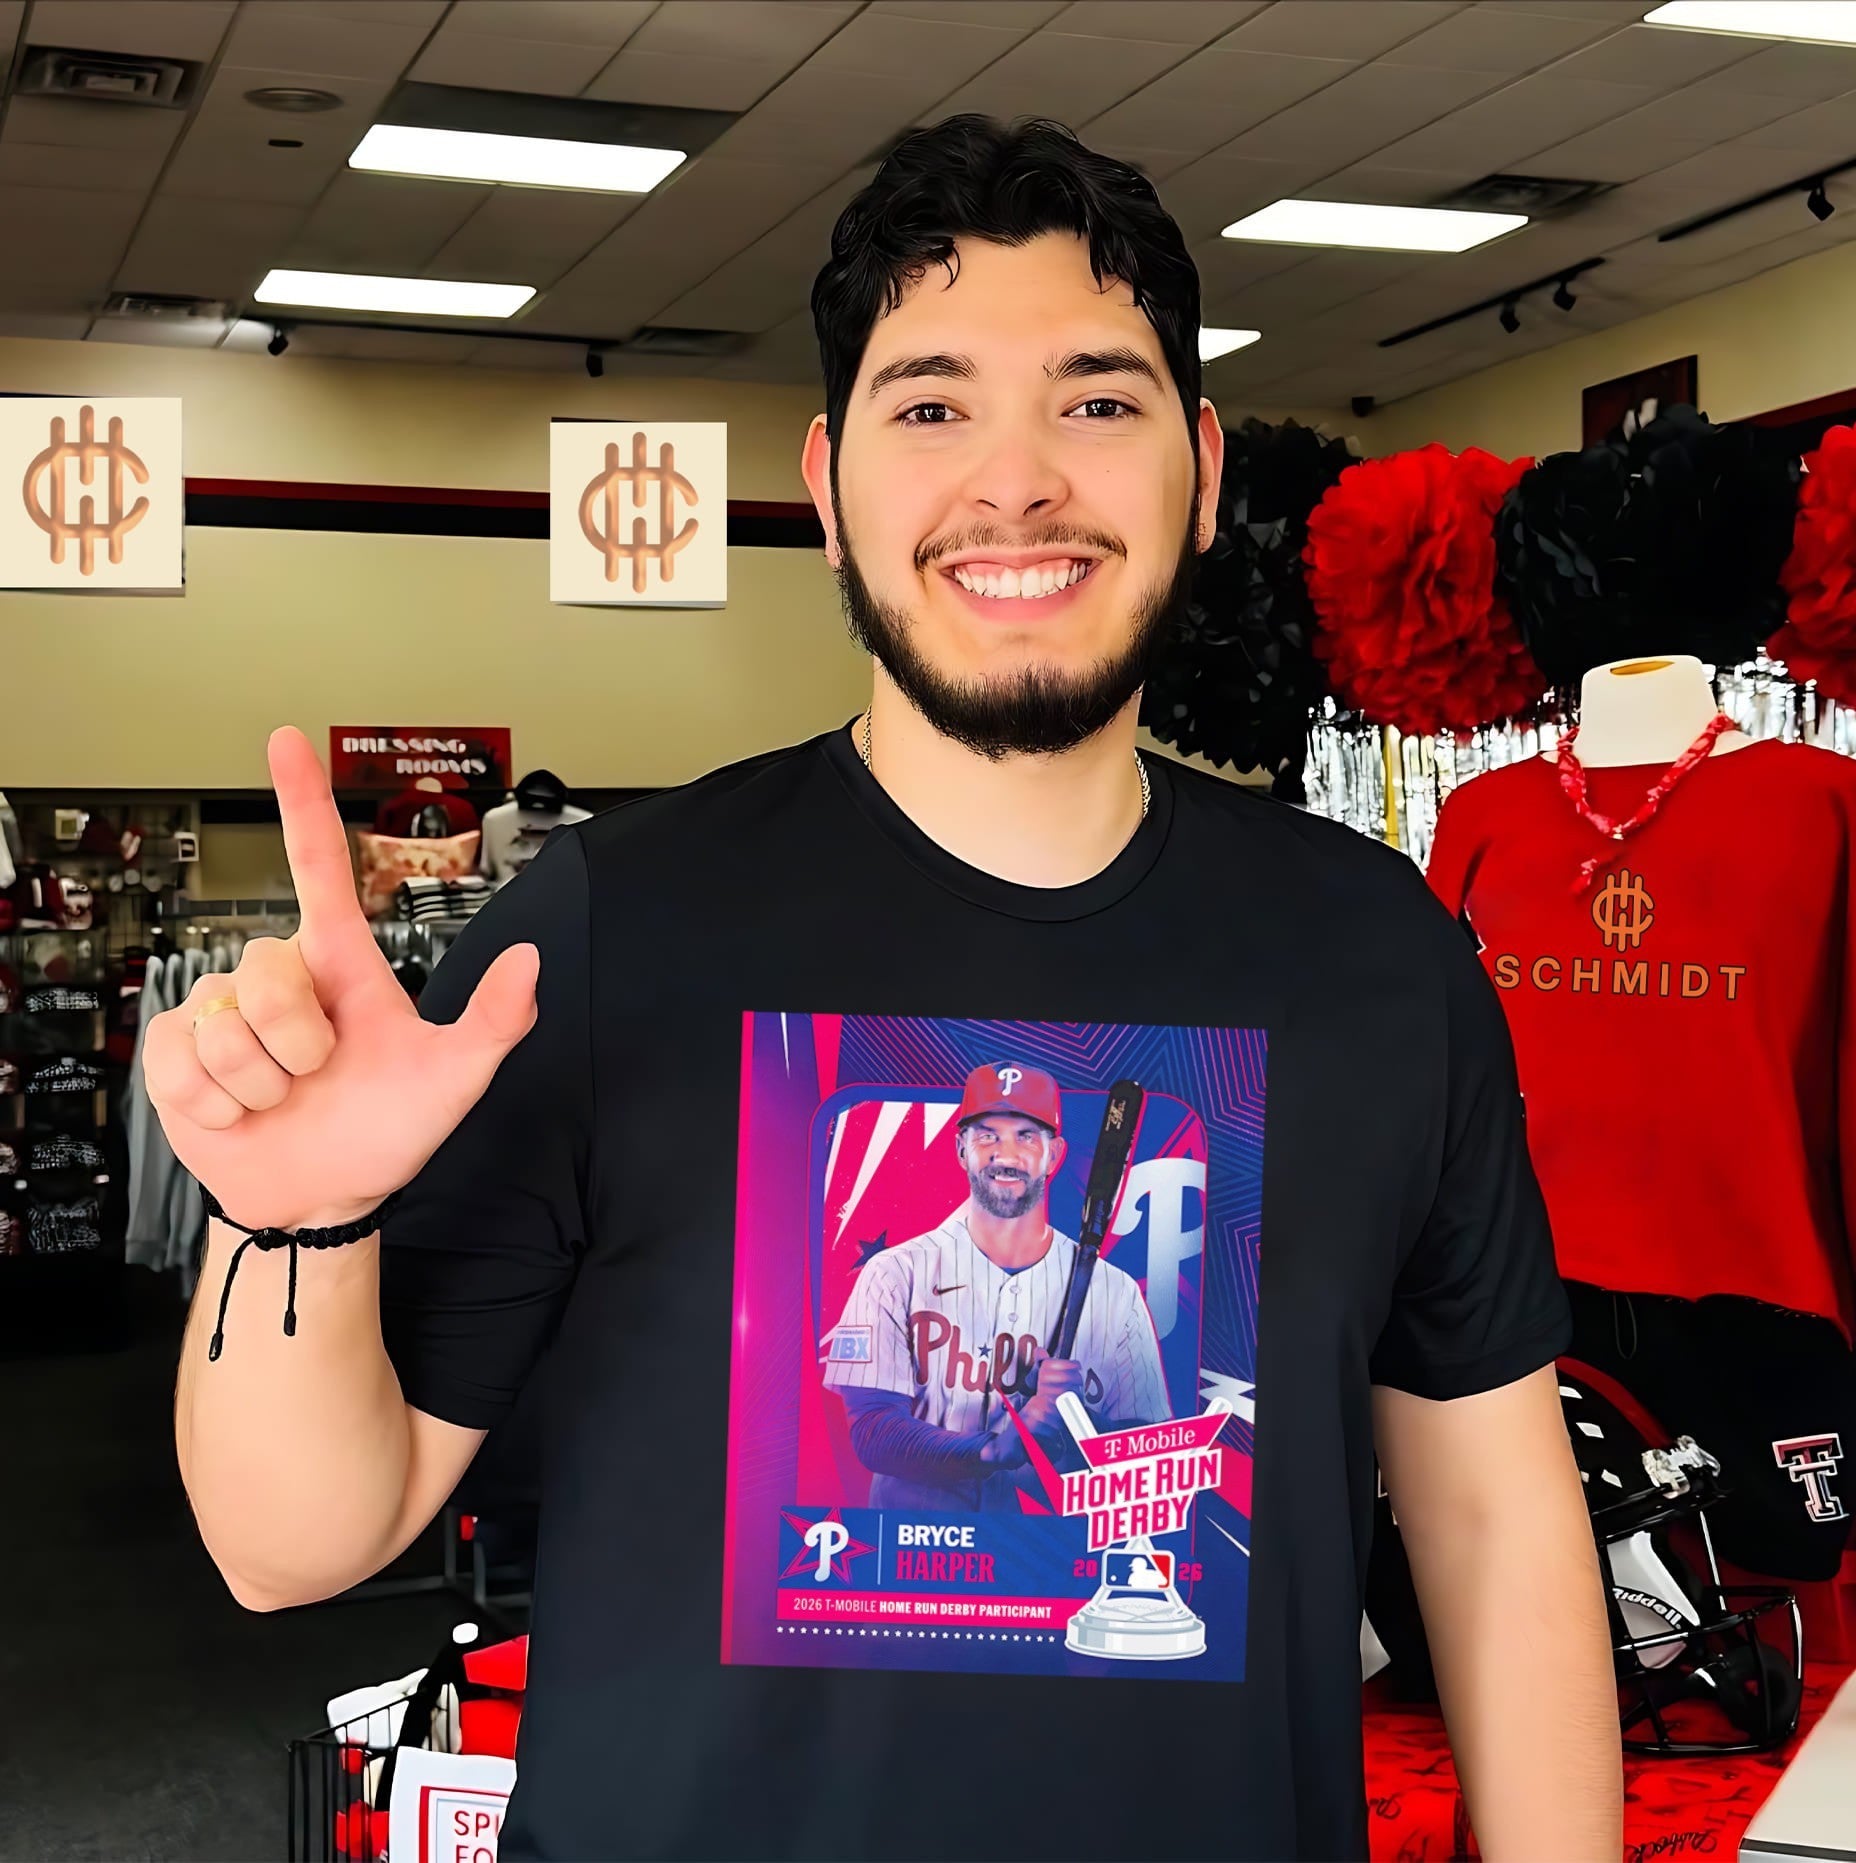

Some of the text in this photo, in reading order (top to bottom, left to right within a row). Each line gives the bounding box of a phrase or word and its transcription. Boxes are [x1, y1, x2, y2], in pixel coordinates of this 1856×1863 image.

[1494, 954, 1746, 1000] SCHMIDT
[998, 1068, 1022, 1096] P
[831, 1337, 869, 1360] IBX
[910, 1311, 1104, 1405] Phills
[1127, 1427, 1195, 1456] Mobile
[1066, 1452, 1219, 1513] HOME RUN
[898, 1524, 975, 1548] BRYCE
[1091, 1495, 1188, 1549] DERBY
[896, 1551, 995, 1583] HARPER
[1073, 1559, 1097, 1577] 20
[1178, 1562, 1203, 1581] 26
[793, 1598, 1052, 1619] 2026 T-MOBILE HOME RUN DERBY PARTICIPANT
